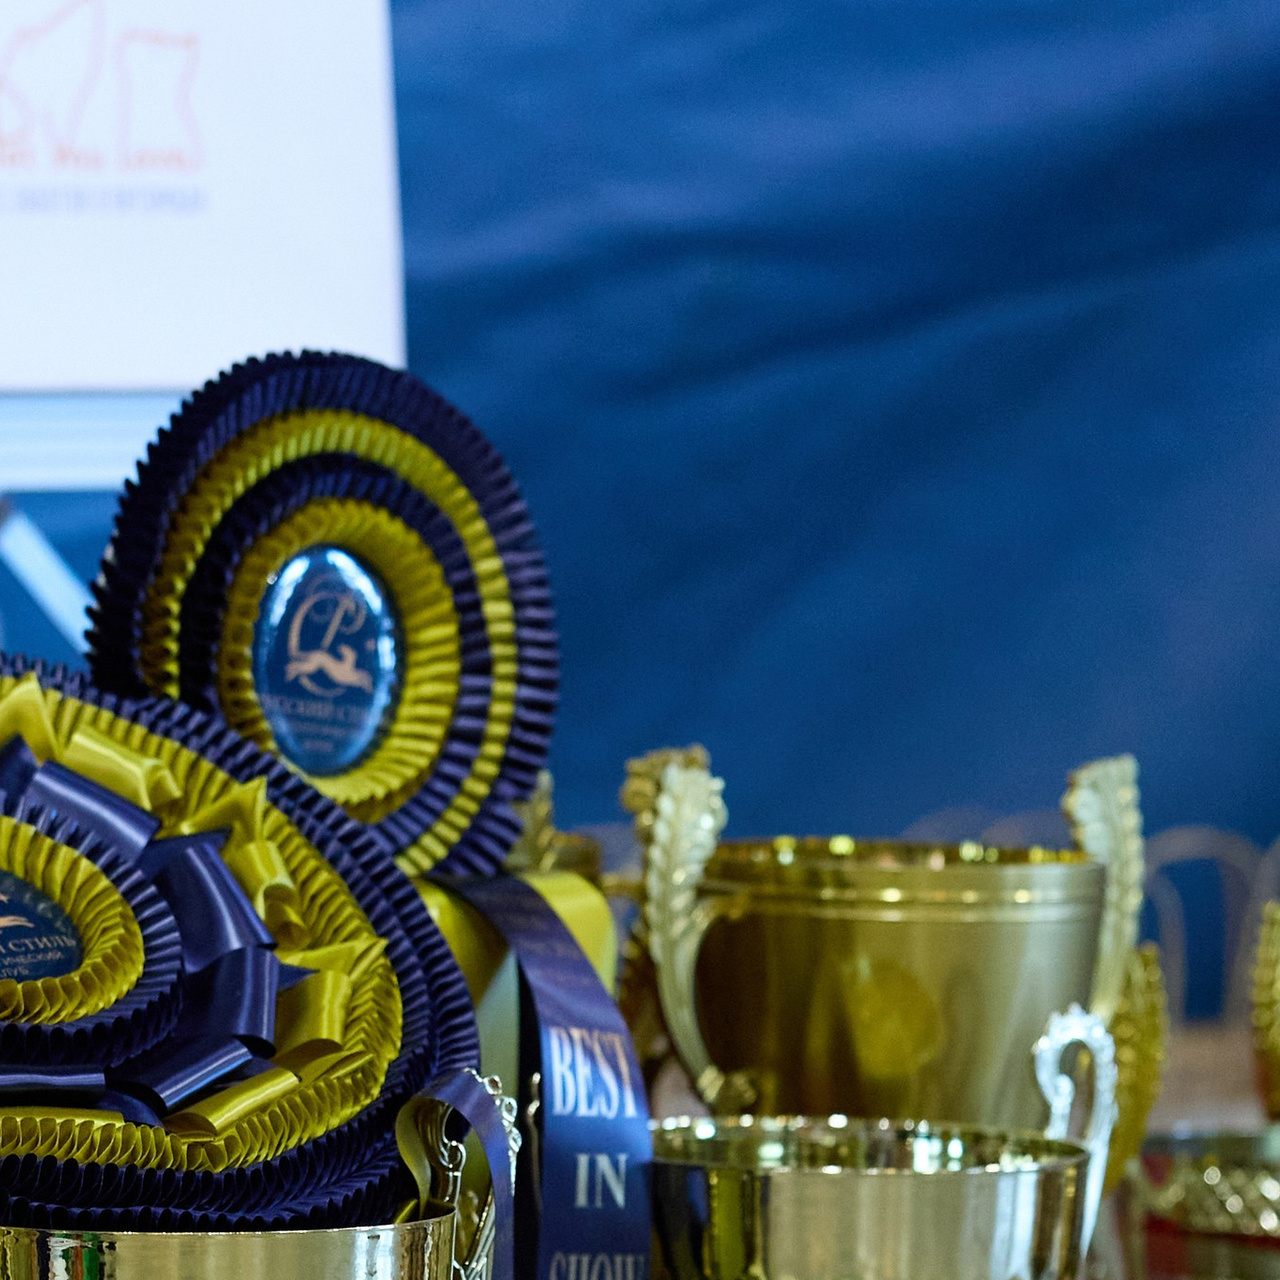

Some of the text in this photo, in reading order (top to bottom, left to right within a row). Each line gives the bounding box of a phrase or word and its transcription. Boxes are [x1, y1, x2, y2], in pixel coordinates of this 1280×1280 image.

[7, 935, 77, 952] СТИЛЬ
[549, 1026, 637, 1120] BEST
[575, 1153, 629, 1209] IN
